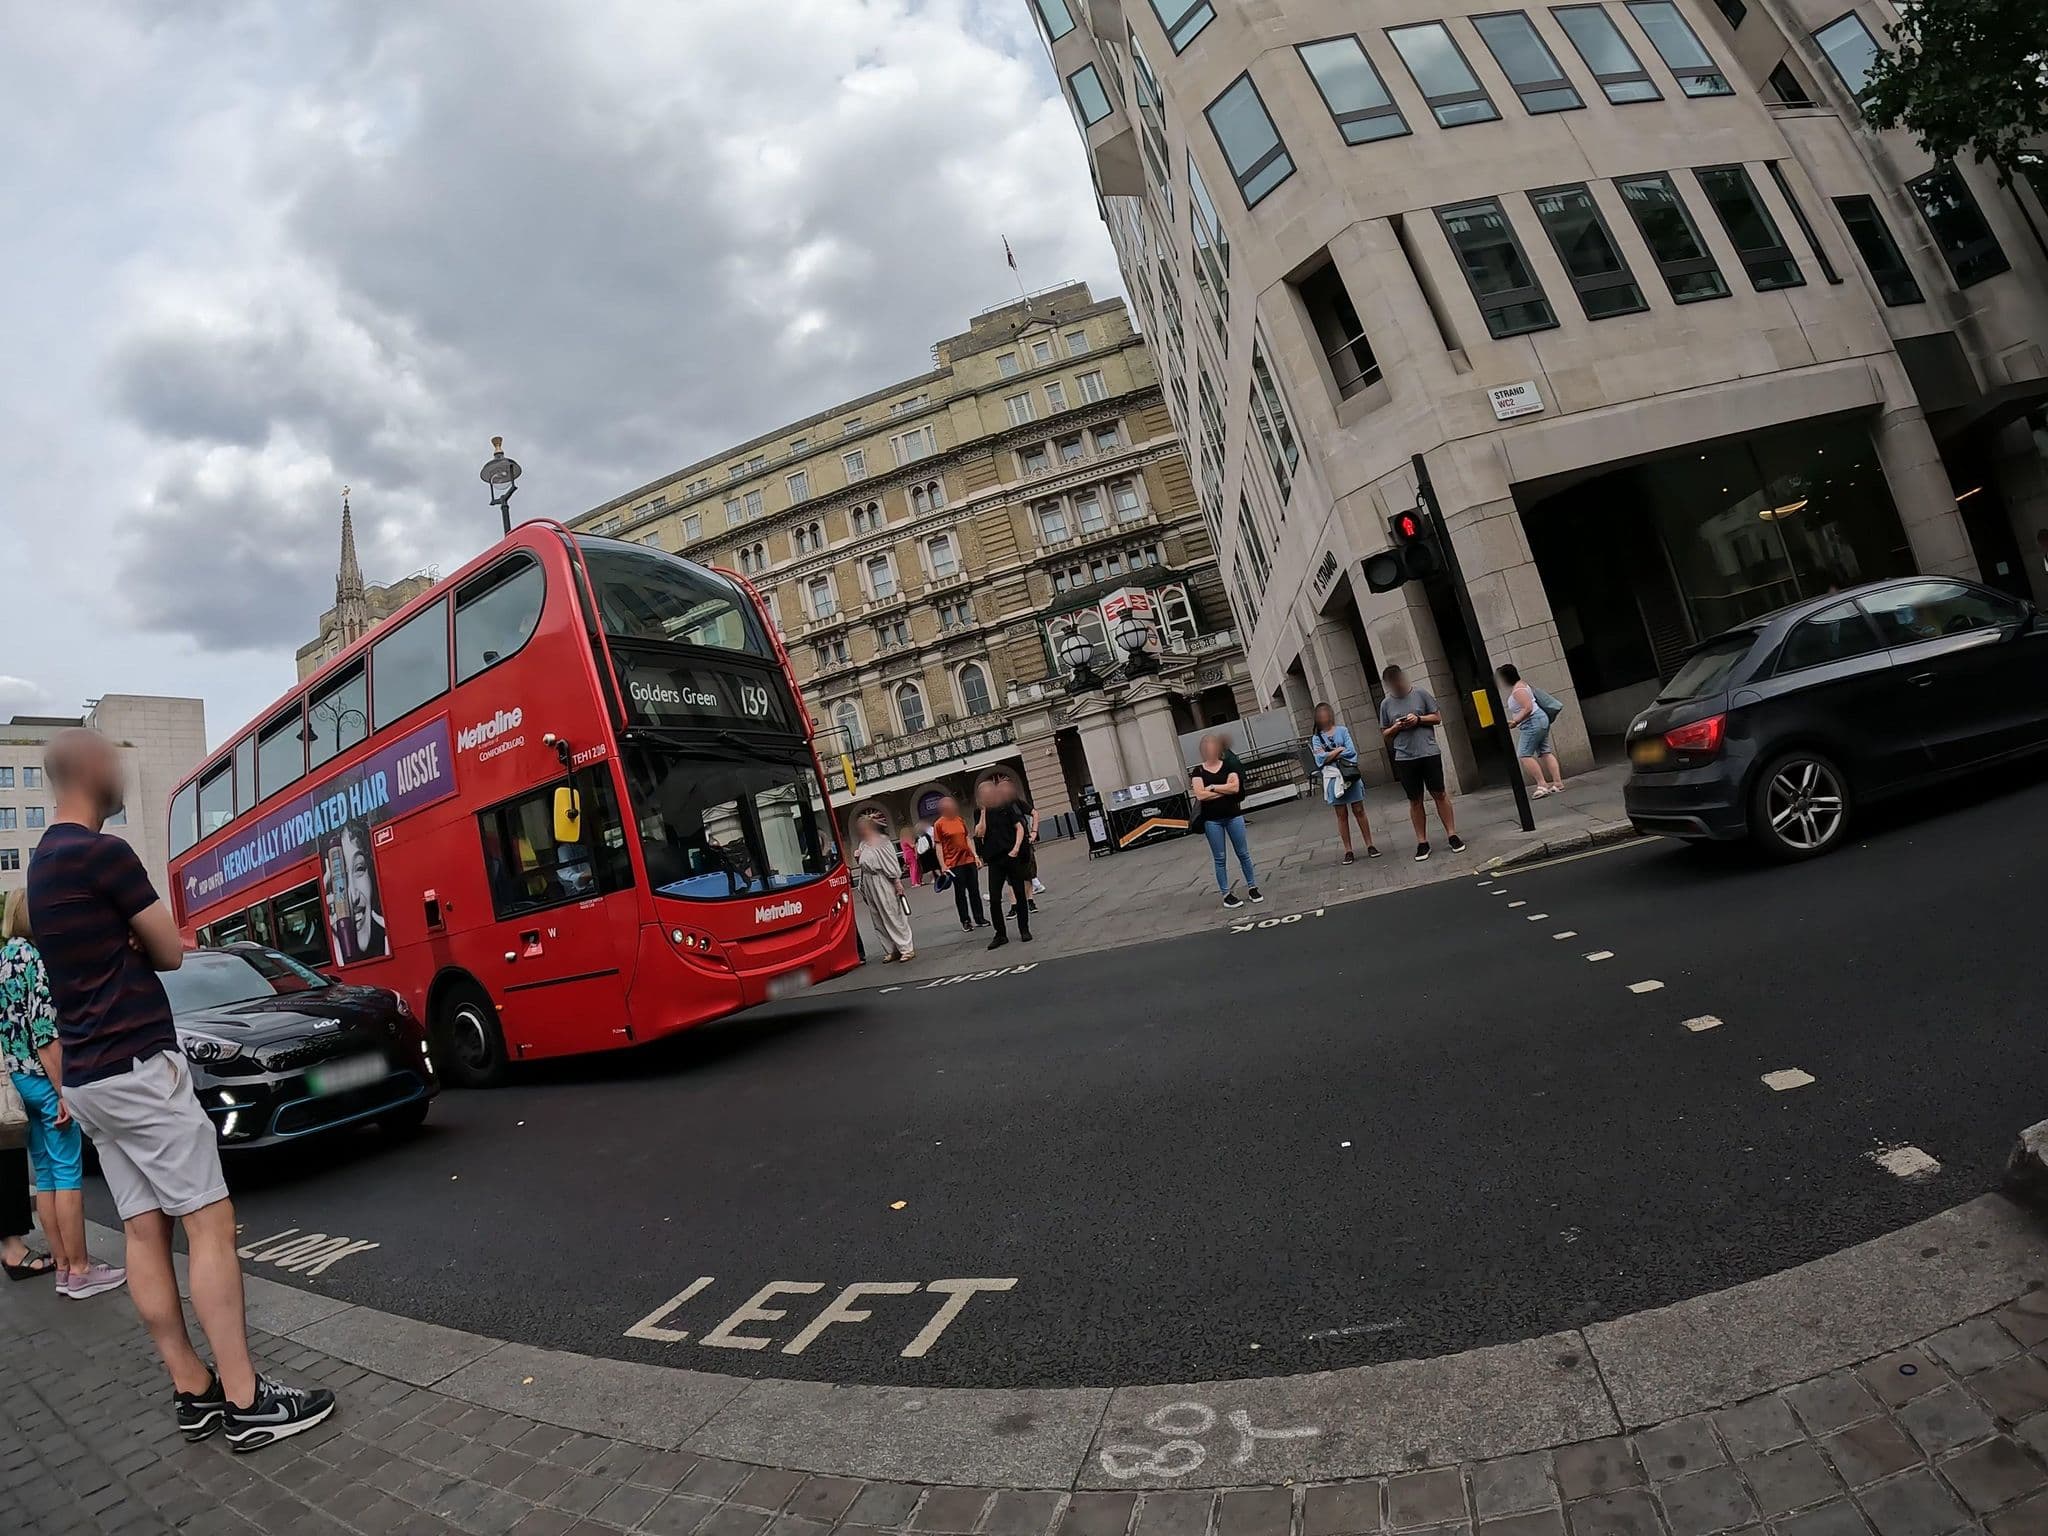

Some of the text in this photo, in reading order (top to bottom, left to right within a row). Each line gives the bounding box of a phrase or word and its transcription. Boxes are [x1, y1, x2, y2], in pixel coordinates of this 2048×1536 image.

[1494, 386, 1525, 399] STRAND
[1497, 399, 1515, 408] WC2
[1316, 550, 1337, 590] STRAND
[629, 681, 769, 716] Golders Green 139
[457, 706, 523, 753] Metroline
[222, 827, 280, 882] HEROICALLY
[281, 792, 349, 853] HYDRATED
[349, 770, 390, 820] HAIR
[396, 741, 441, 796] AUSSIE
[755, 900, 803, 924] Metroline
[1230, 909, 1326, 935] LOOK
[547, 928, 557, 938] W
[915, 963, 1039, 990] RIGHT
[236, 1228, 380, 1276] LOOK
[623, 1275, 1019, 1358] LEFT
